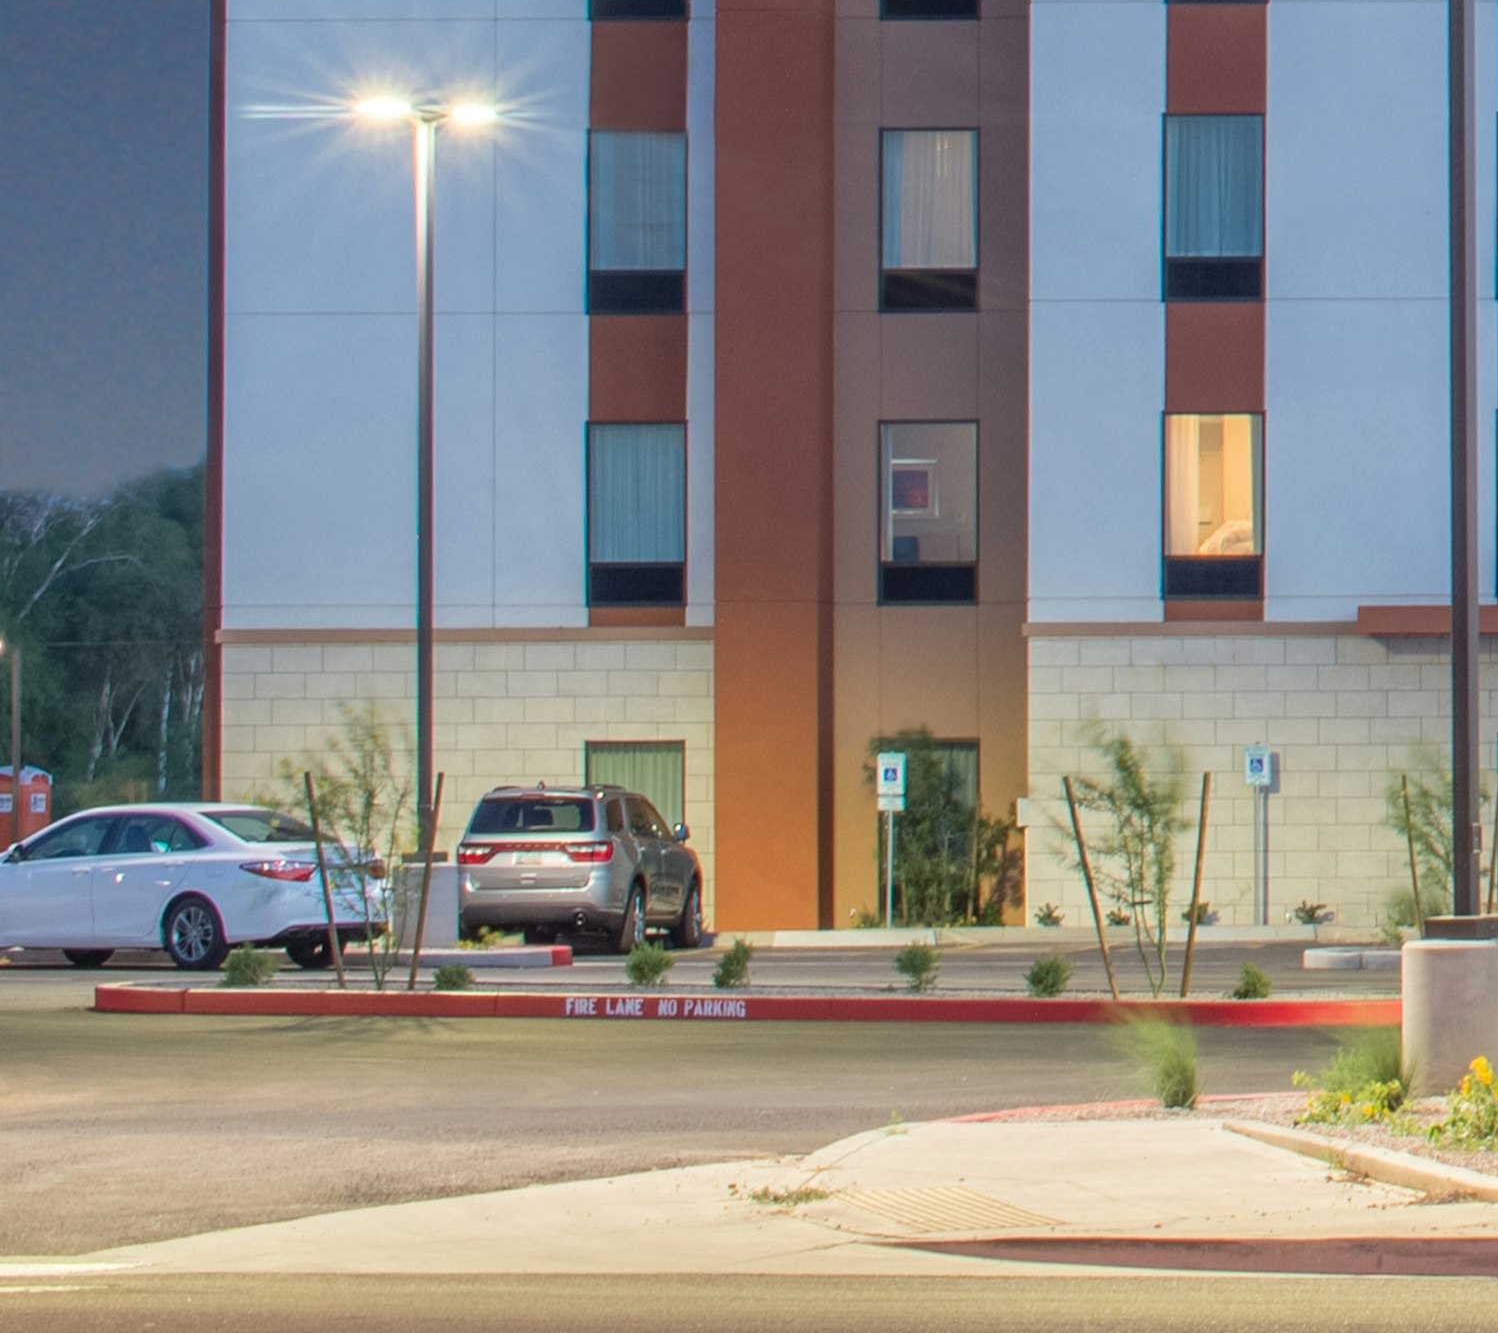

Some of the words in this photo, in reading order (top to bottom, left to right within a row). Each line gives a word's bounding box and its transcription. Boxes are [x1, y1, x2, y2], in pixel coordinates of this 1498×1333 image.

[565, 998, 598, 1016] FIRE
[605, 998, 644, 1016] LANE
[657, 999, 677, 1016] NO
[684, 999, 746, 1018] PARKING
